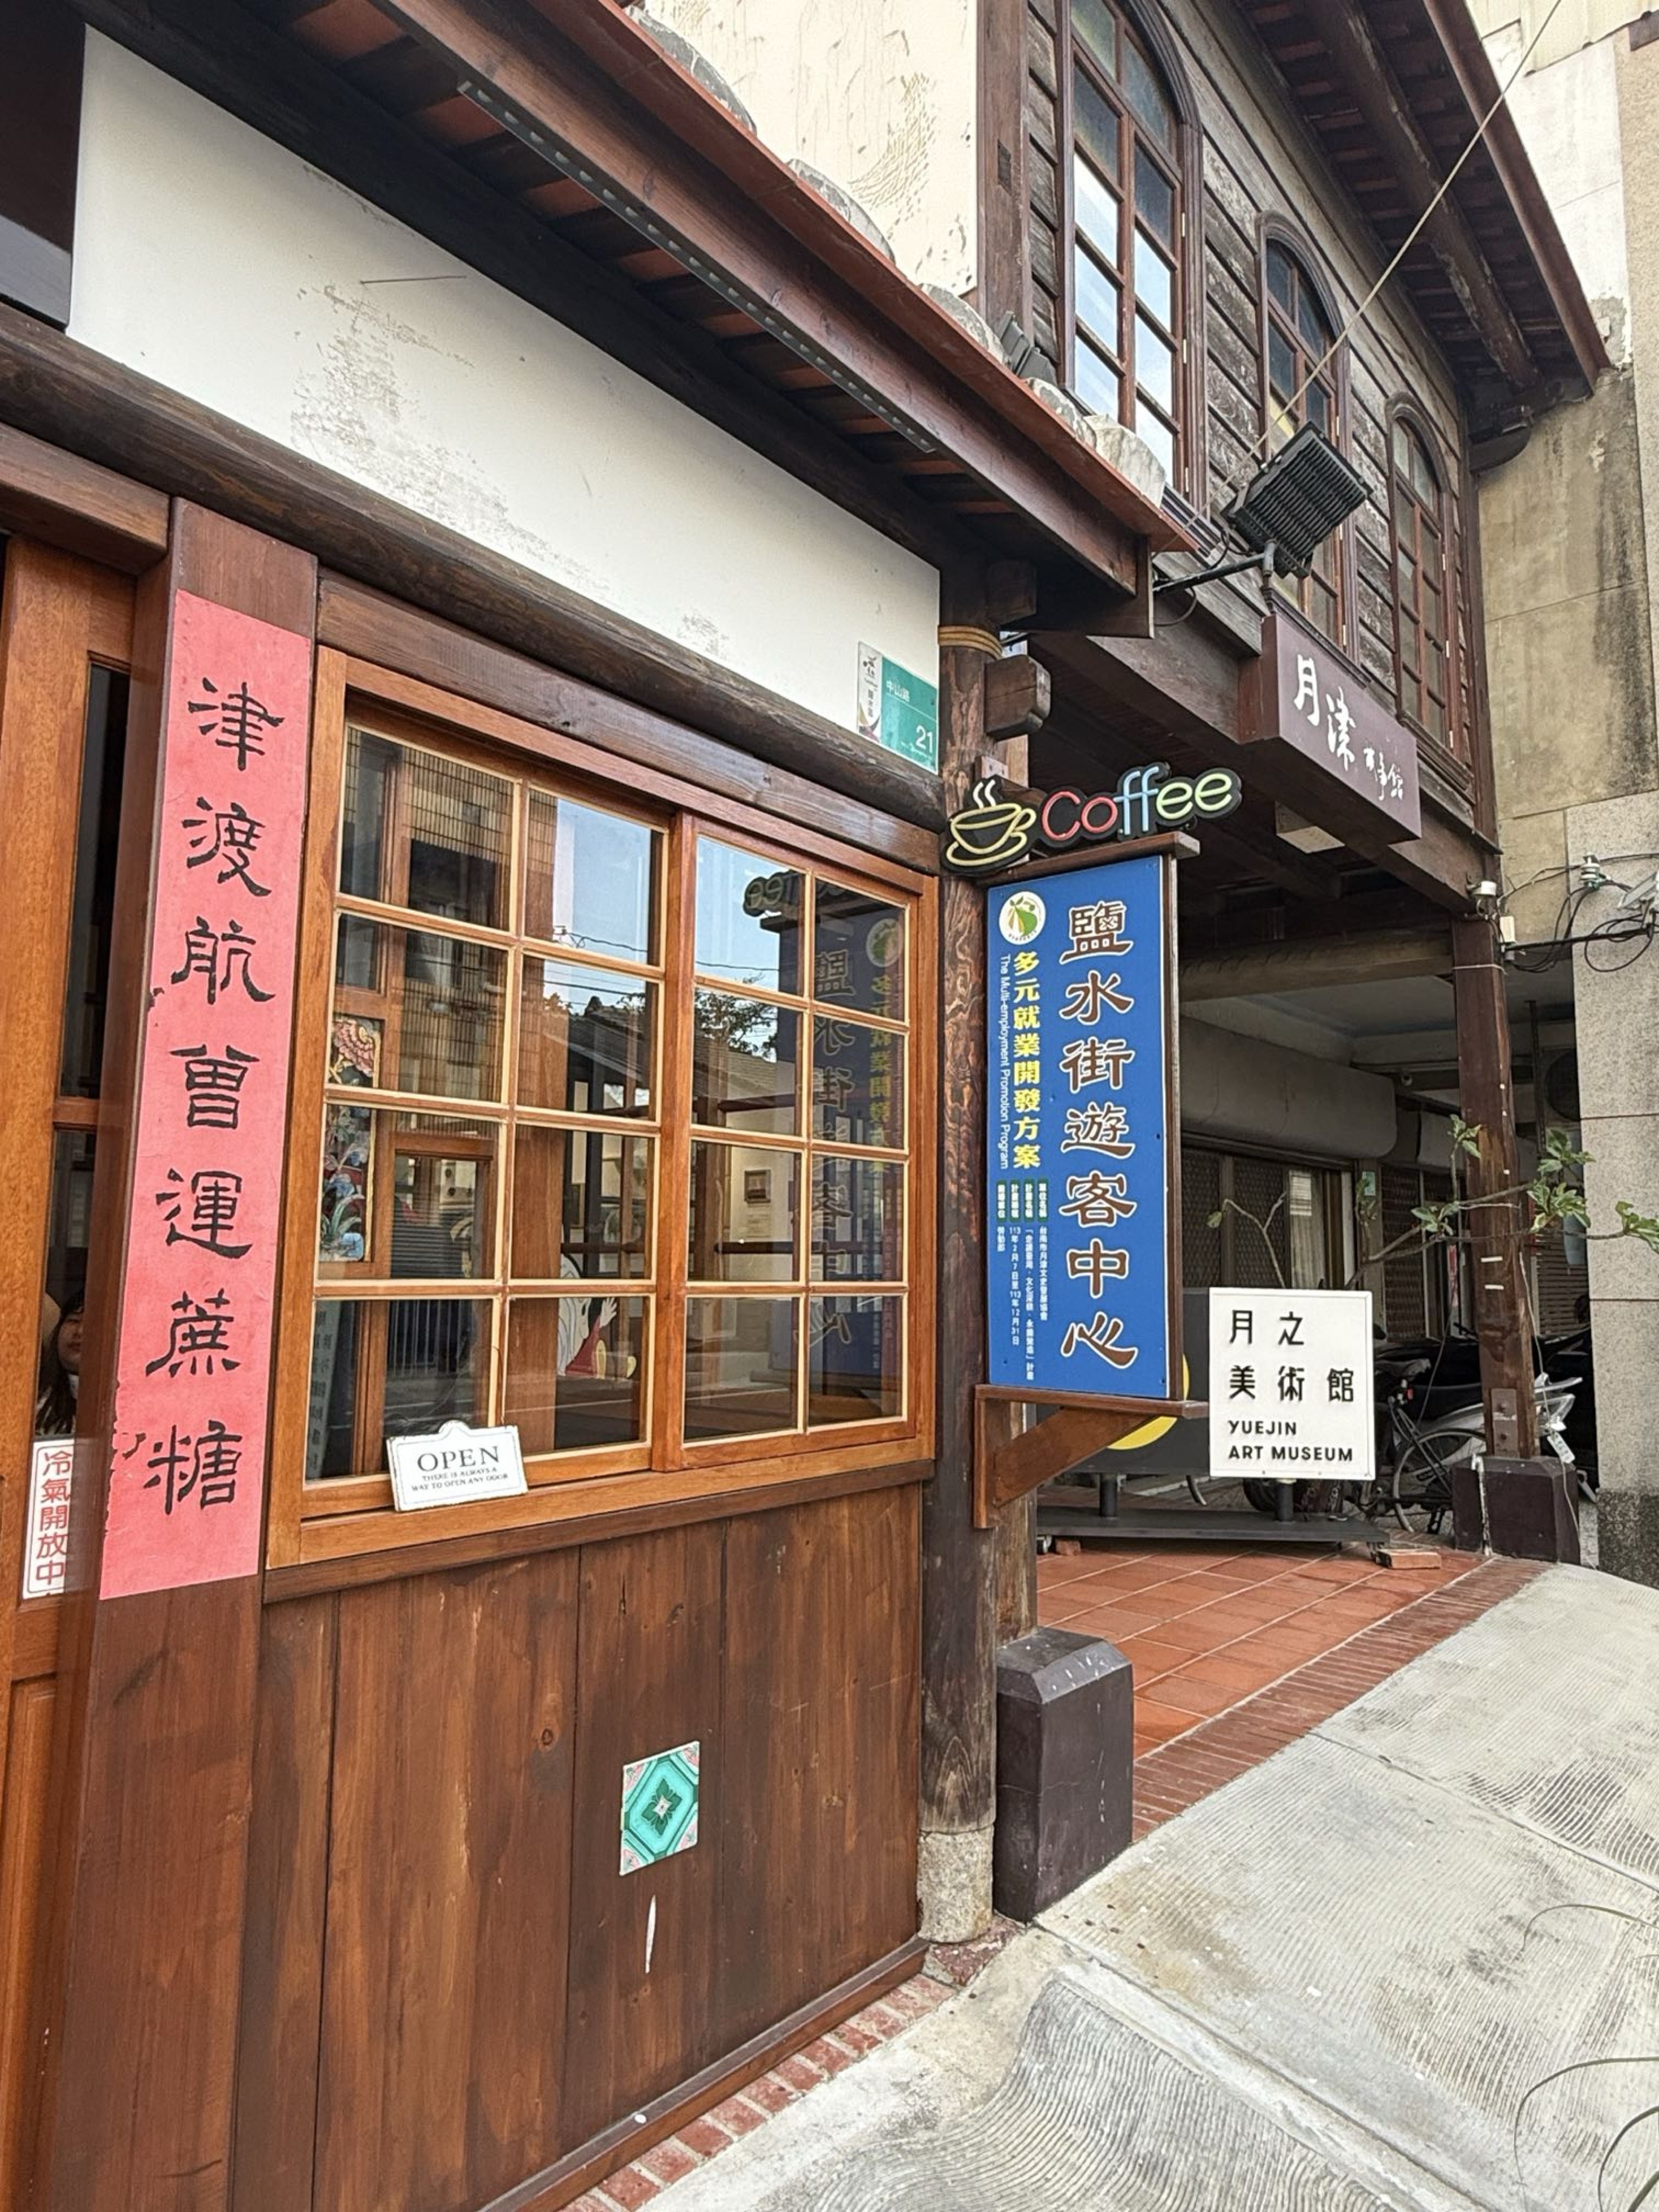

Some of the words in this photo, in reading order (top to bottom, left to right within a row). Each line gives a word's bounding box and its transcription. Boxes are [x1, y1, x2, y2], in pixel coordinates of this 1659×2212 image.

[915, 725, 933, 753] 21
[1042, 765, 1232, 841] Coffee
[1000, 953, 1010, 974] The
[999, 976, 1010, 1066] Multi-employment
[1013, 951, 1040, 1169] 多元就業開發方案
[1000, 1069, 1011, 1122] Promotion
[998, 1124, 1011, 1169] Program
[1058, 900, 1138, 1369] 鹽水街遊客中心
[1230, 1310, 1304, 1345] 月之
[1229, 1365, 1354, 1402] 美術館
[1228, 1420, 1297, 1435] YUEJIN
[417, 1446, 500, 1472] OPEN
[1229, 1446, 1263, 1459] ART
[1271, 1446, 1353, 1461] MUSEUM
[422, 1473, 448, 1481] THERE
[460, 1468, 490, 1476] ALWAYS
[444, 1479, 466, 1487] OPEN
[485, 1473, 508, 1481] DOOR
[36, 1450, 72, 1586] 冷氣開放中
